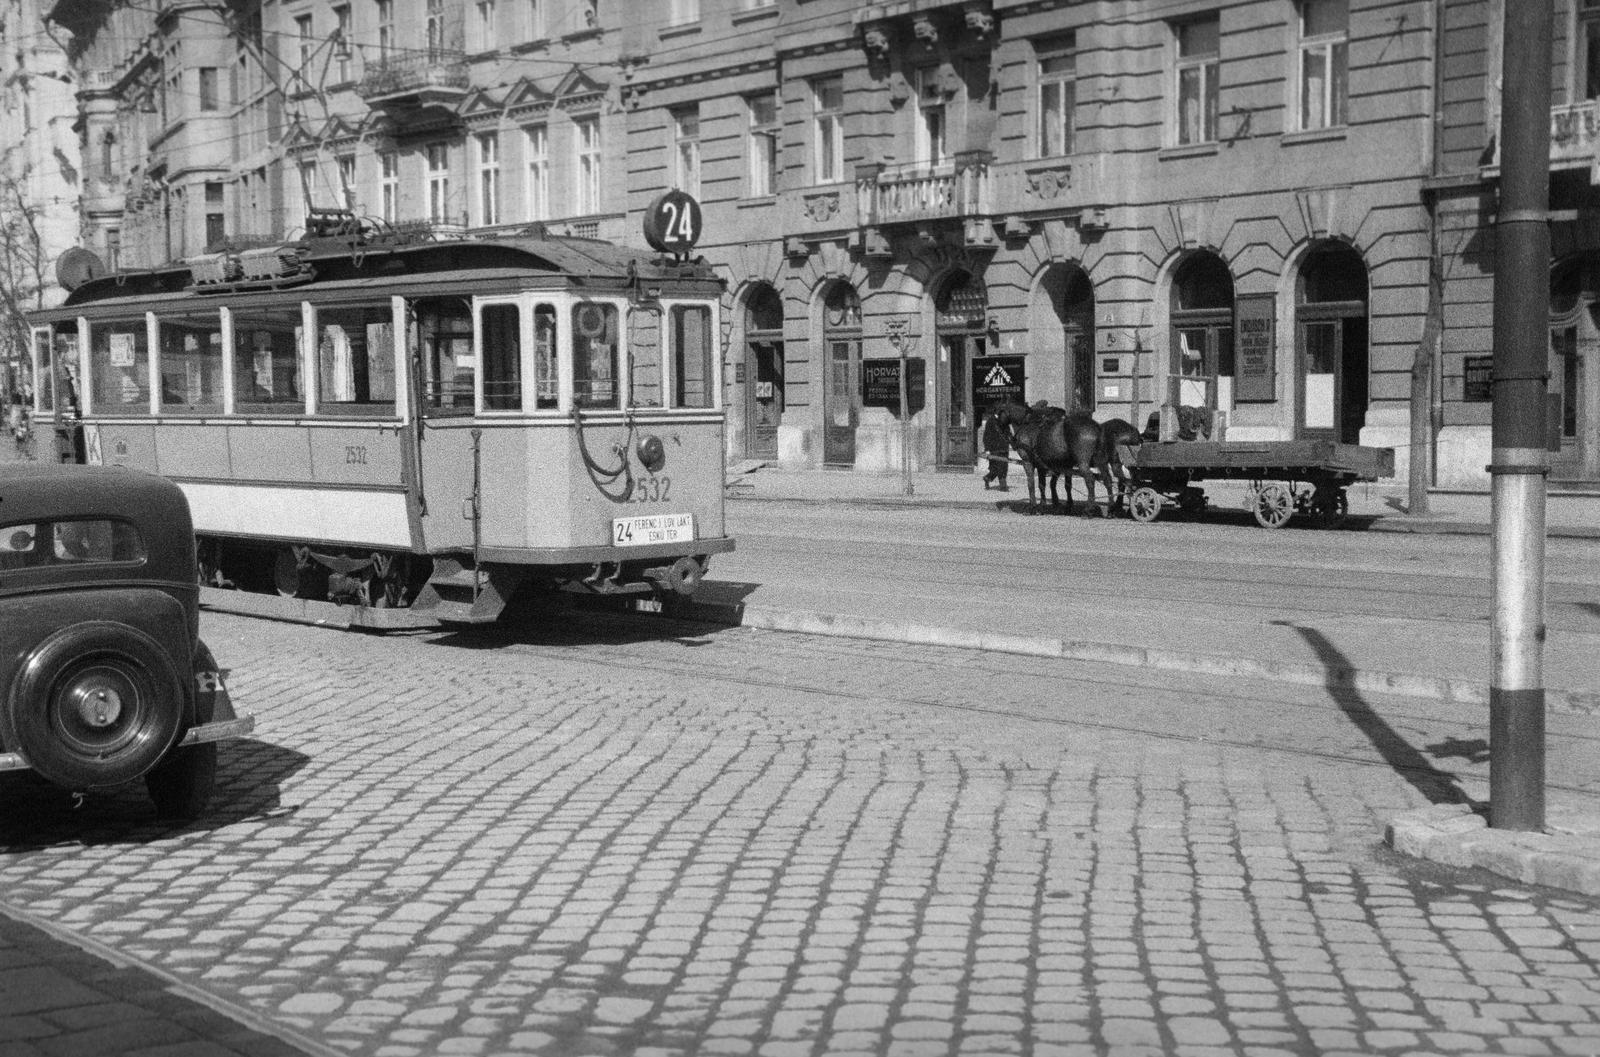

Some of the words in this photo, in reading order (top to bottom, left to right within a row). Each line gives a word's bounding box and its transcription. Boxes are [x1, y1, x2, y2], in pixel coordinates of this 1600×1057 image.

[662, 202, 692, 242] 24
[345, 445, 368, 465] 2532
[617, 522, 633, 542] 24
[634, 518, 657, 531] FERENC
